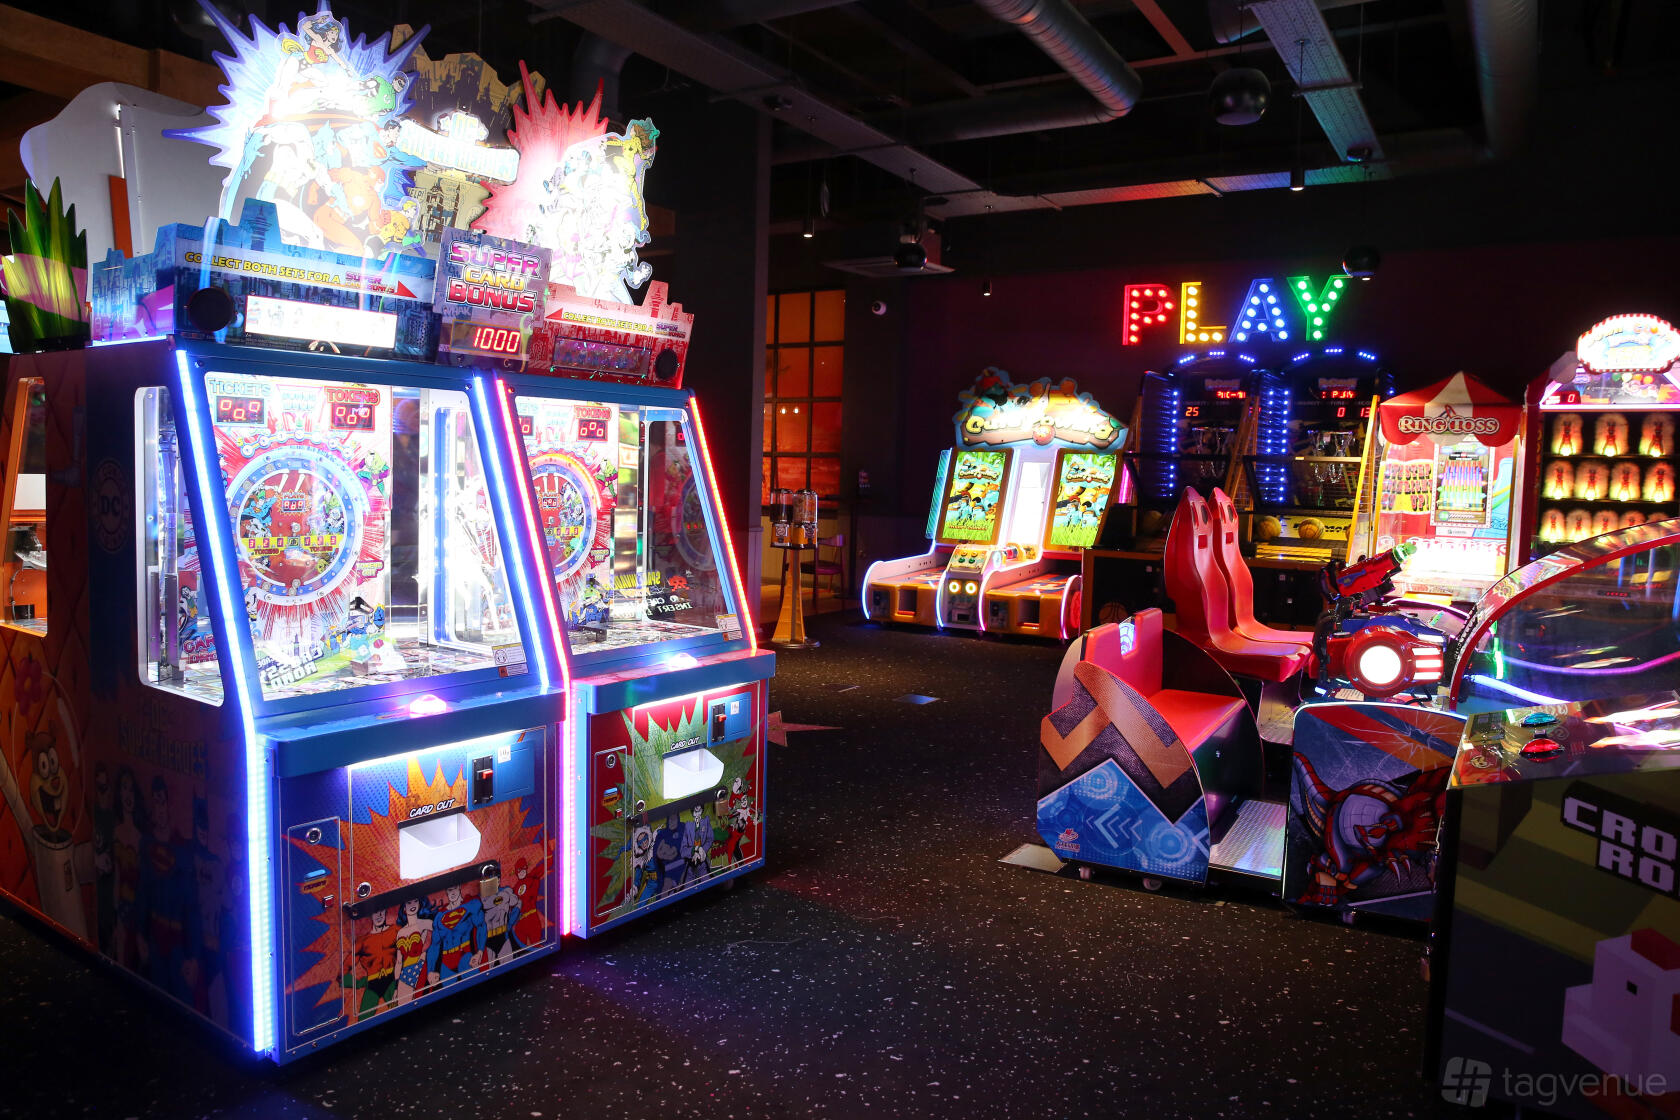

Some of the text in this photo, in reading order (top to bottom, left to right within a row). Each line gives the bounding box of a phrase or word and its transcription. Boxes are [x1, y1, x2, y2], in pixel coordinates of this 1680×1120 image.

[451, 242, 538, 275] SUPER
[243, 261, 277, 275] BOTH
[279, 267, 305, 280] SETS
[307, 272, 330, 285] FOR
[332, 275, 341, 284] A
[466, 266, 525, 291] CARD
[449, 280, 535, 312] BONUS
[1122, 274, 1353, 346] PLAY
[563, 312, 594, 323] COLLECT
[596, 317, 616, 326] BOTH
[617, 320, 633, 330] SETS
[473, 327, 520, 352] 1000
[209, 379, 271, 396] TICKETS
[327, 388, 379, 403] TOKENS
[575, 407, 611, 419] TOKENS
[1185, 406, 1199, 416] 25
[1337, 407, 1346, 417] 0
[1399, 415, 1498, 434] RING TOSS
[671, 736, 700, 750] CARD OUT
[410, 798, 455, 817] CARD OUT
[1598, 840, 1680, 896] RO
